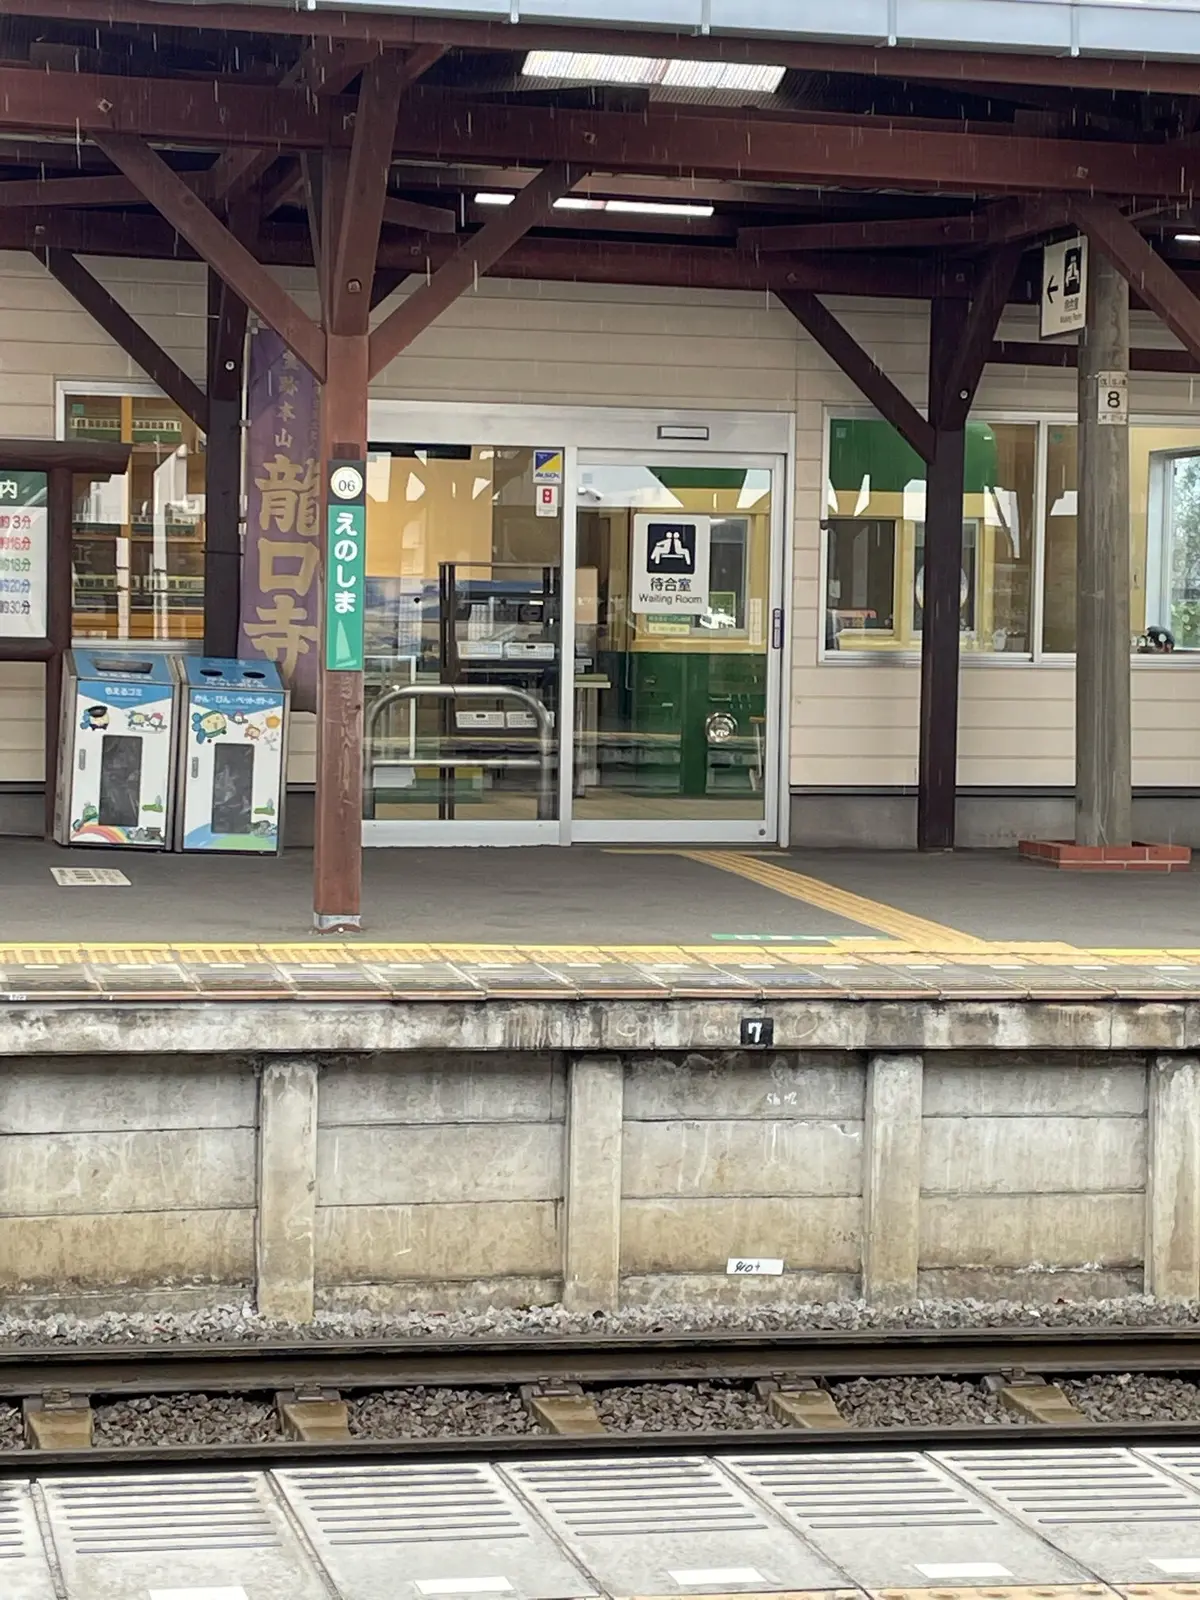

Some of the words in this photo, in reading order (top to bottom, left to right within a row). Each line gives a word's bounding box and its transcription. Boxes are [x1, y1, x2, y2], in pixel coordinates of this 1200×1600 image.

[1107, 391, 1120, 408] 8
[338, 478, 356, 492] 06
[334, 511, 358, 614] えのしま
[650, 577, 692, 592] 待合室
[638, 593, 673, 605] Waiting
[675, 594, 702, 604] Room
[747, 1022, 762, 1043] 7
